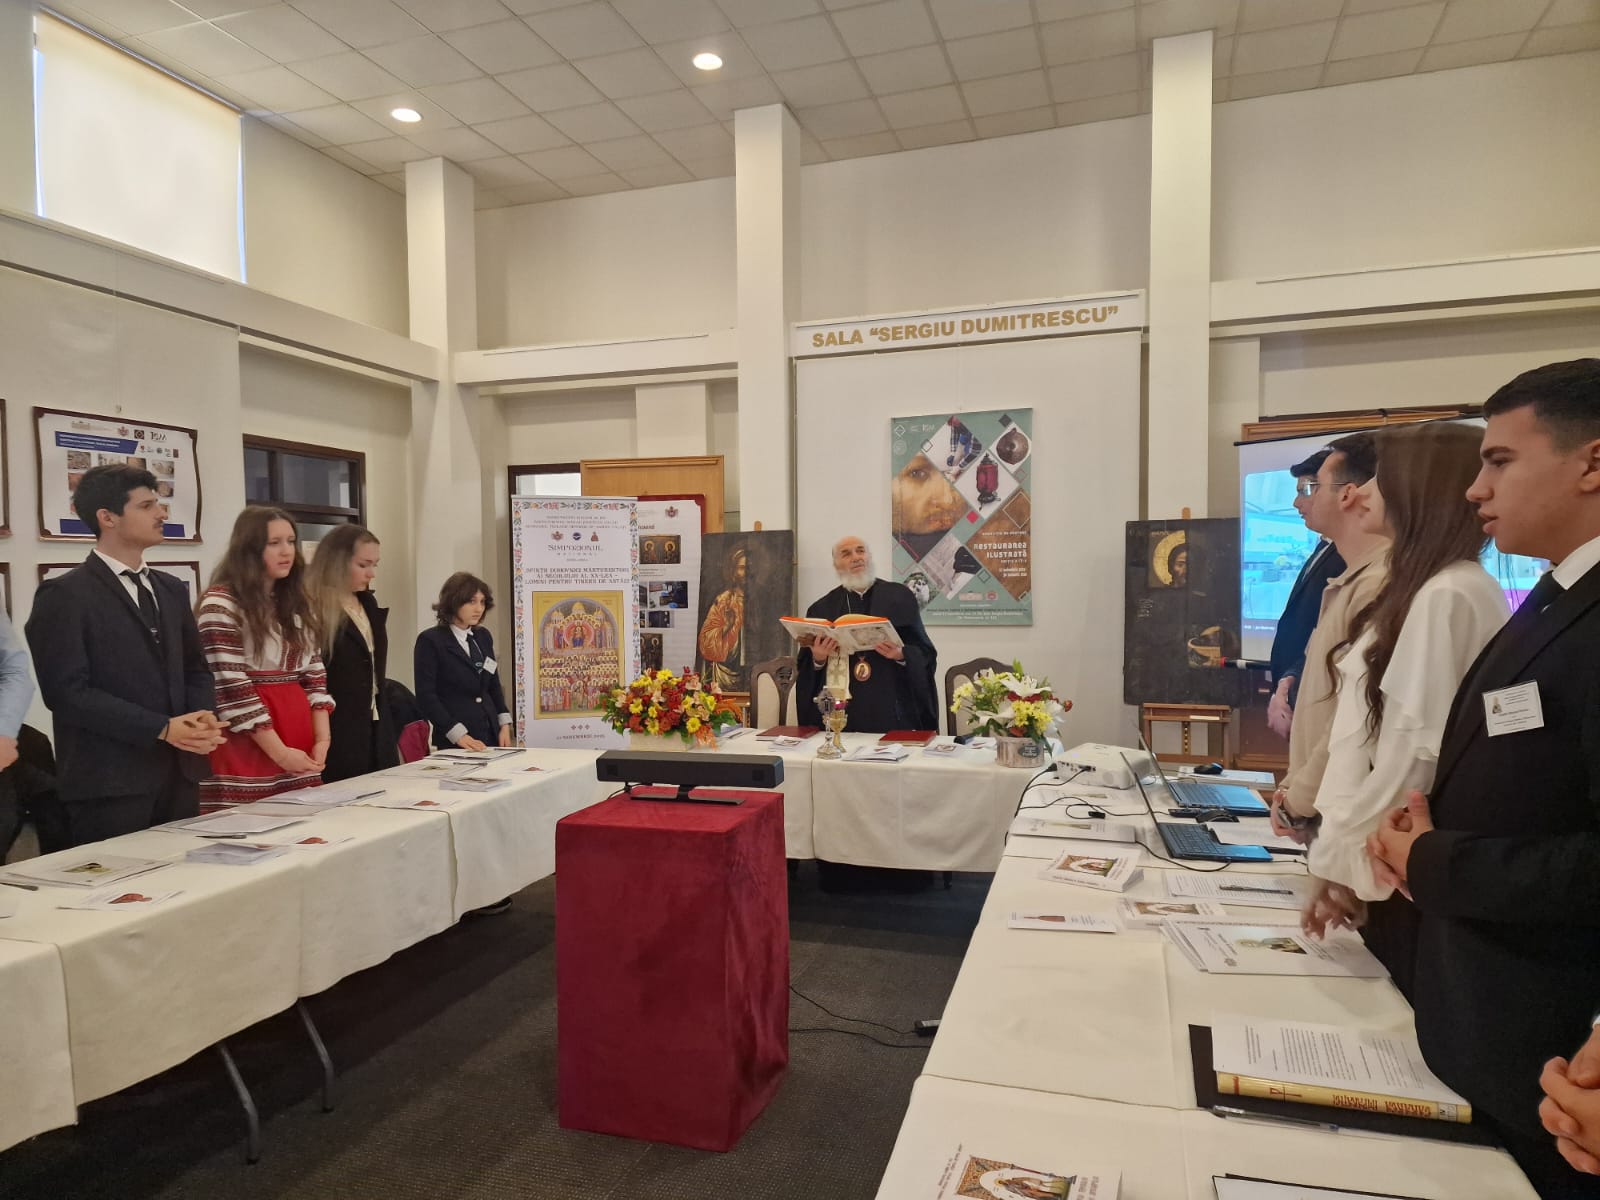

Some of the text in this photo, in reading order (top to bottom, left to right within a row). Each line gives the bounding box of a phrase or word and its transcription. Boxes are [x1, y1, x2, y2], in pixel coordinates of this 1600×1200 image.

[812, 305, 1119, 348] SALA “SERGIU DUMITRESCU”
